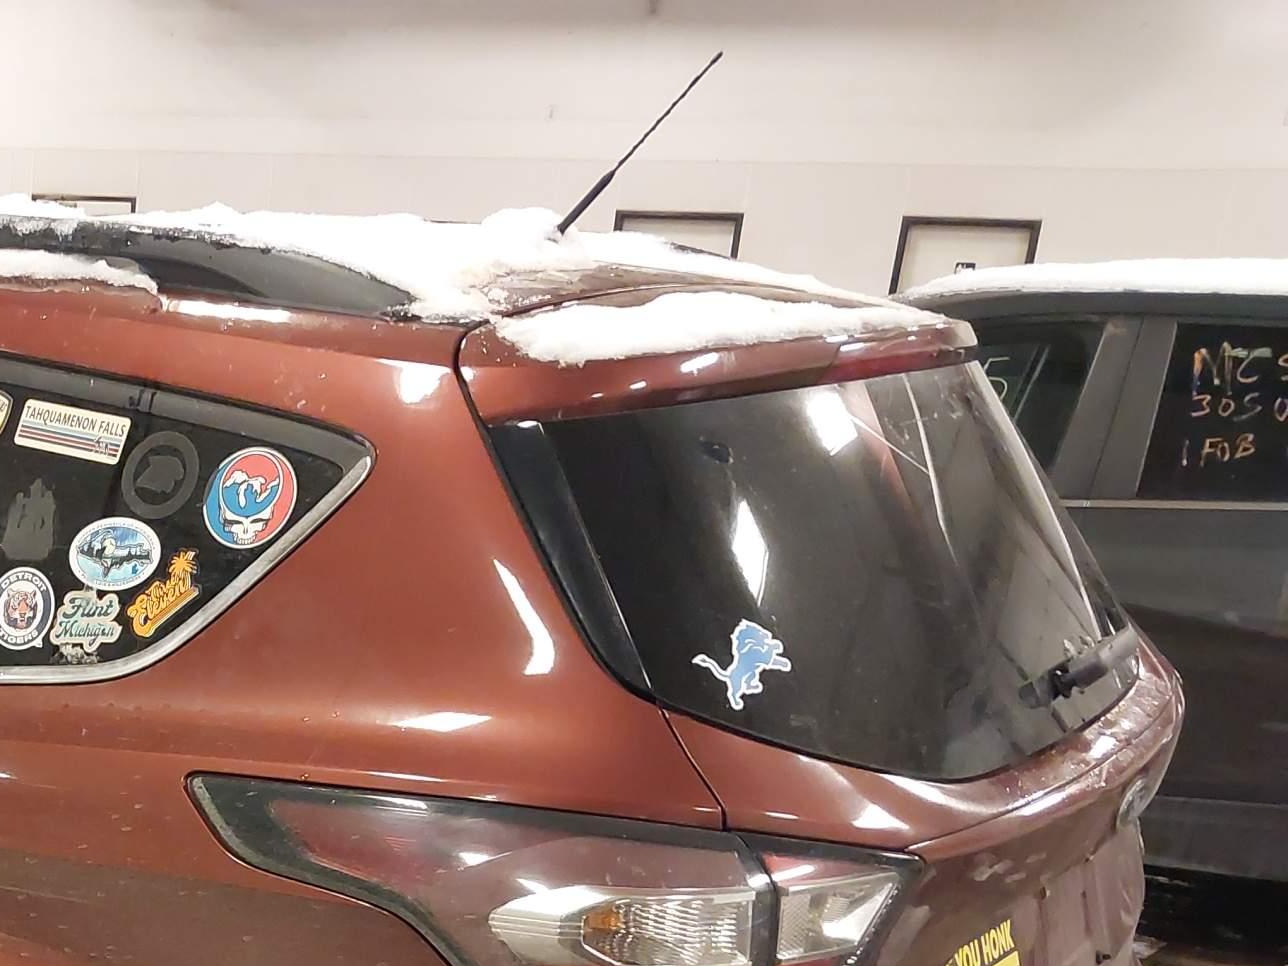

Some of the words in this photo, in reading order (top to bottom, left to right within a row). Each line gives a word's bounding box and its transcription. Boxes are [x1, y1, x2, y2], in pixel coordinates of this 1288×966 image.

[25, 405, 98, 432] TAHQUAMENON
[98, 420, 126, 438] FALLS
[1200, 433, 1256, 467] FOB
[1, 572, 47, 592] DETROIT
[62, 597, 114, 619] Flint
[55, 620, 115, 647] Michigan
[980, 919, 1015, 965] HONK
